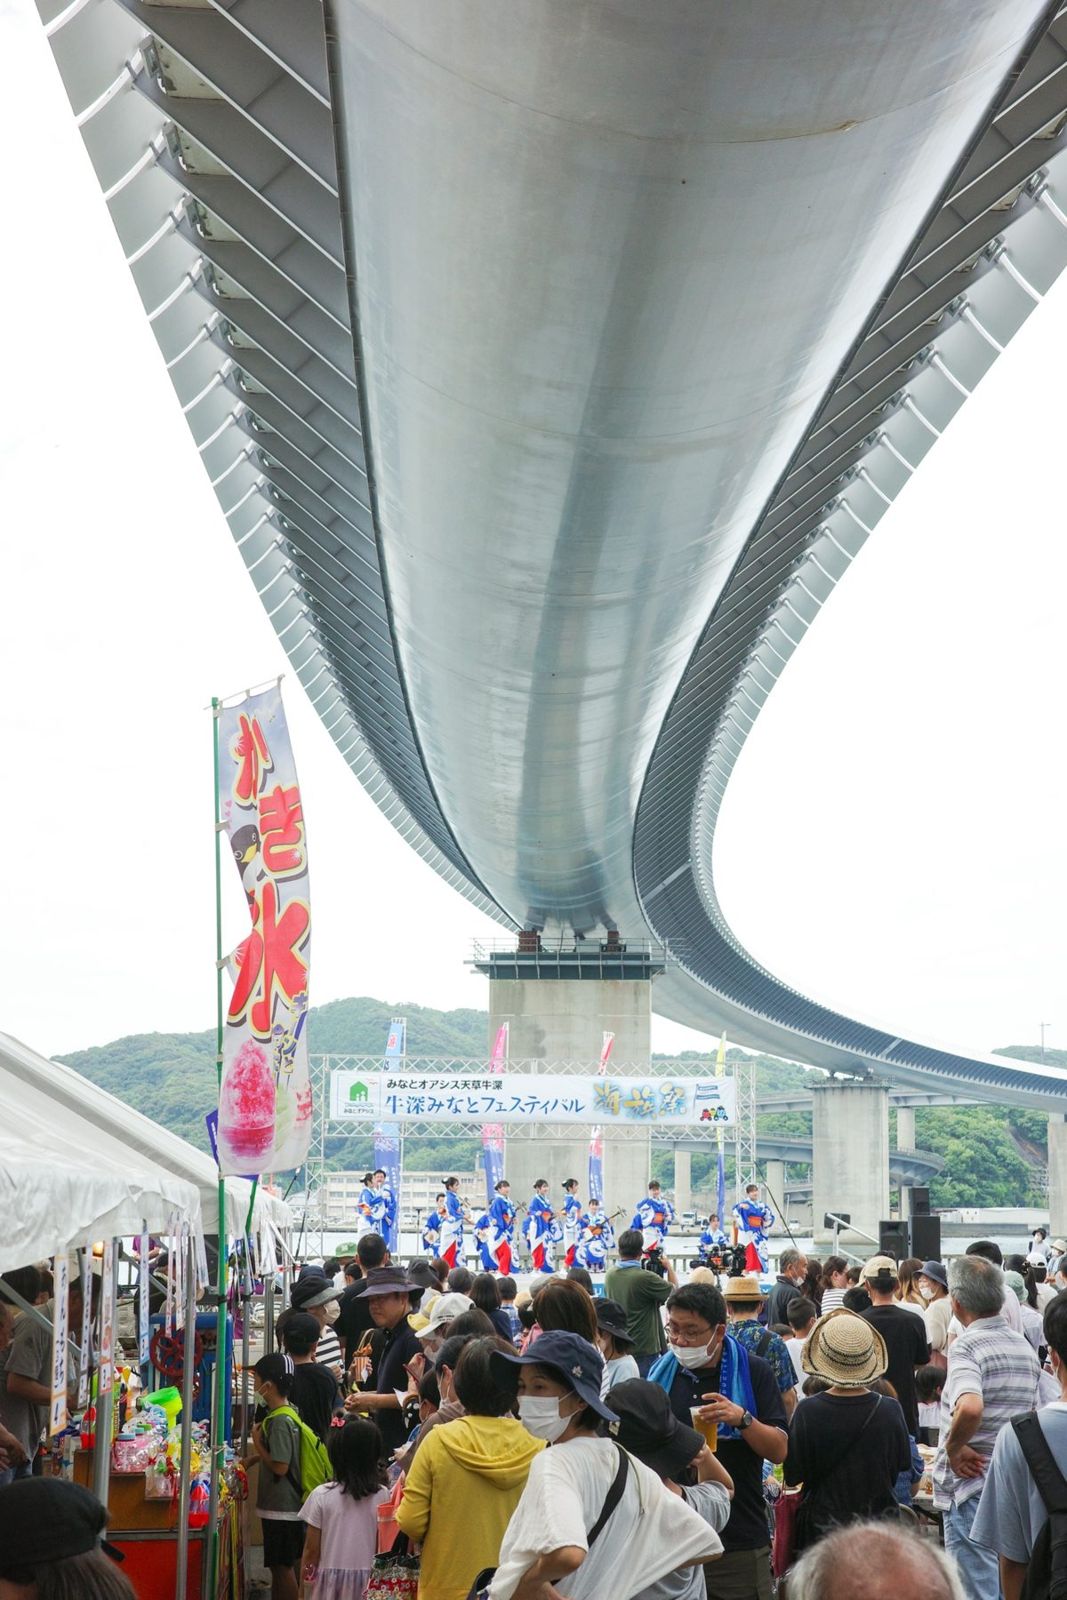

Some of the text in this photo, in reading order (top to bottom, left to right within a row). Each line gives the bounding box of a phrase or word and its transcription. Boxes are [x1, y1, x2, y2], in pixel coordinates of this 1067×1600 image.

[227, 711, 311, 1035] かき氷
[386, 1079, 503, 1091] みなとオアシス天草牛深
[385, 1095, 585, 1115] 牛深みなとフェスティバル
